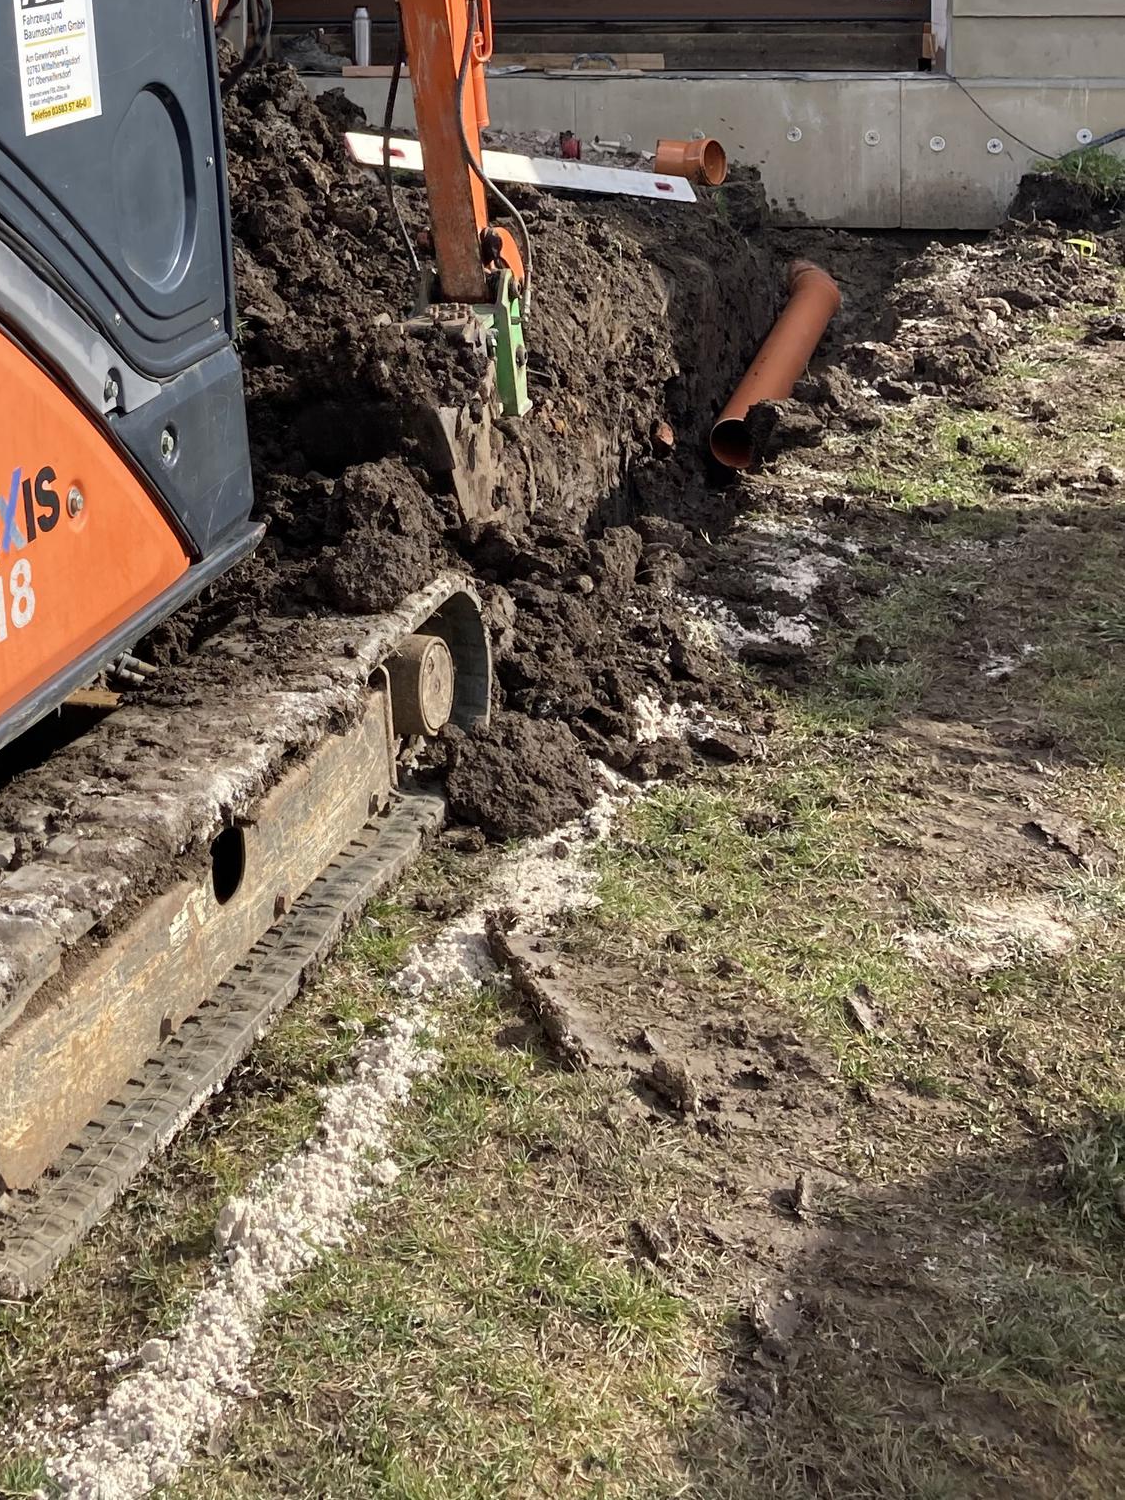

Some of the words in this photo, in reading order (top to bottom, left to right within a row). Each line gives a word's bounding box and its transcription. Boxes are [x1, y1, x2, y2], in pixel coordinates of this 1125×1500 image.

[23, 13, 51, 26] Fahrzeug
[51, 9, 63, 21] und
[24, 24, 68, 40] Baumaschinen
[68, 19, 86, 32] GmbH
[31, 109, 52, 122] Telefon
[51, 103, 68, 116] 03583
[68, 101, 75, 111] 57
[75, 97, 87, 108] 46-0
